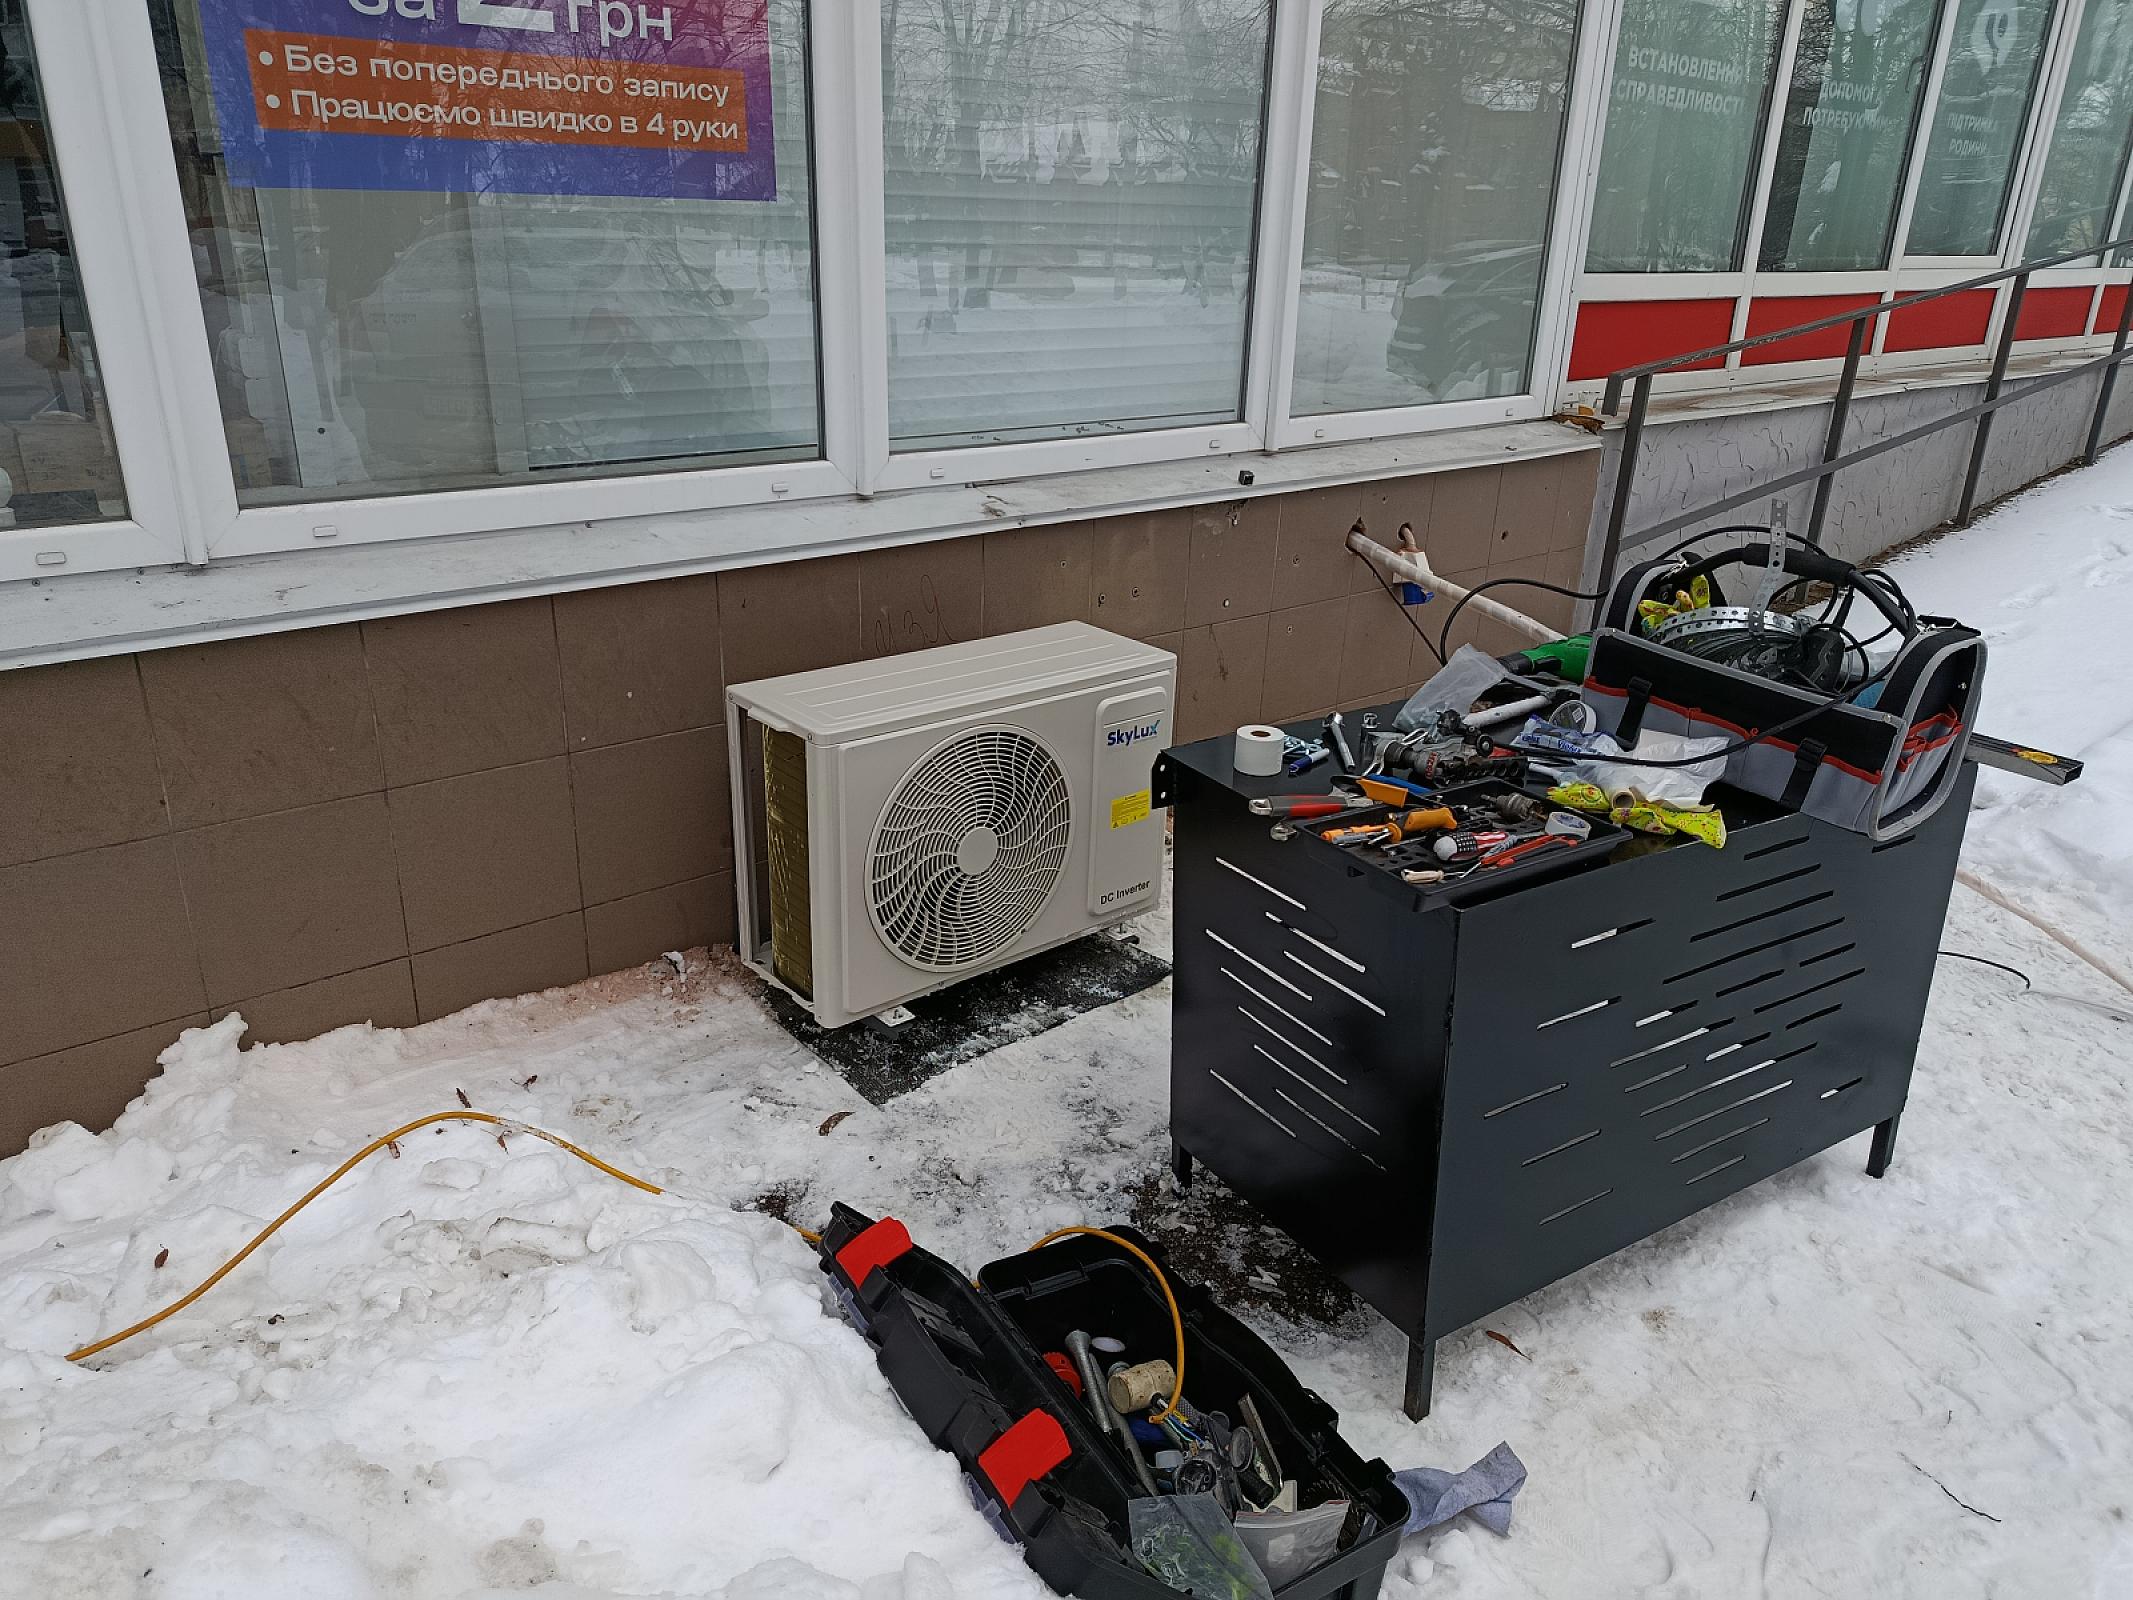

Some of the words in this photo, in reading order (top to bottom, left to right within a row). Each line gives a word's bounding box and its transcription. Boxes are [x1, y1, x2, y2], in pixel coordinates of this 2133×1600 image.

[567, 0, 673, 47] грн
[284, 44, 358, 76] Без
[369, 58, 614, 95] попереднього
[623, 78, 729, 107] запису
[1819, 81, 1885, 104] ДОПОМОГ
[291, 89, 481, 126] Працюємо
[489, 107, 613, 134] швидко
[620, 116, 638, 133] в
[646, 112, 665, 135] 4
[673, 118, 738, 142] руки
[1107, 719, 1161, 746] SkyLux
[1100, 892, 1114, 905] DC
[1116, 880, 1150, 899] Inverter
